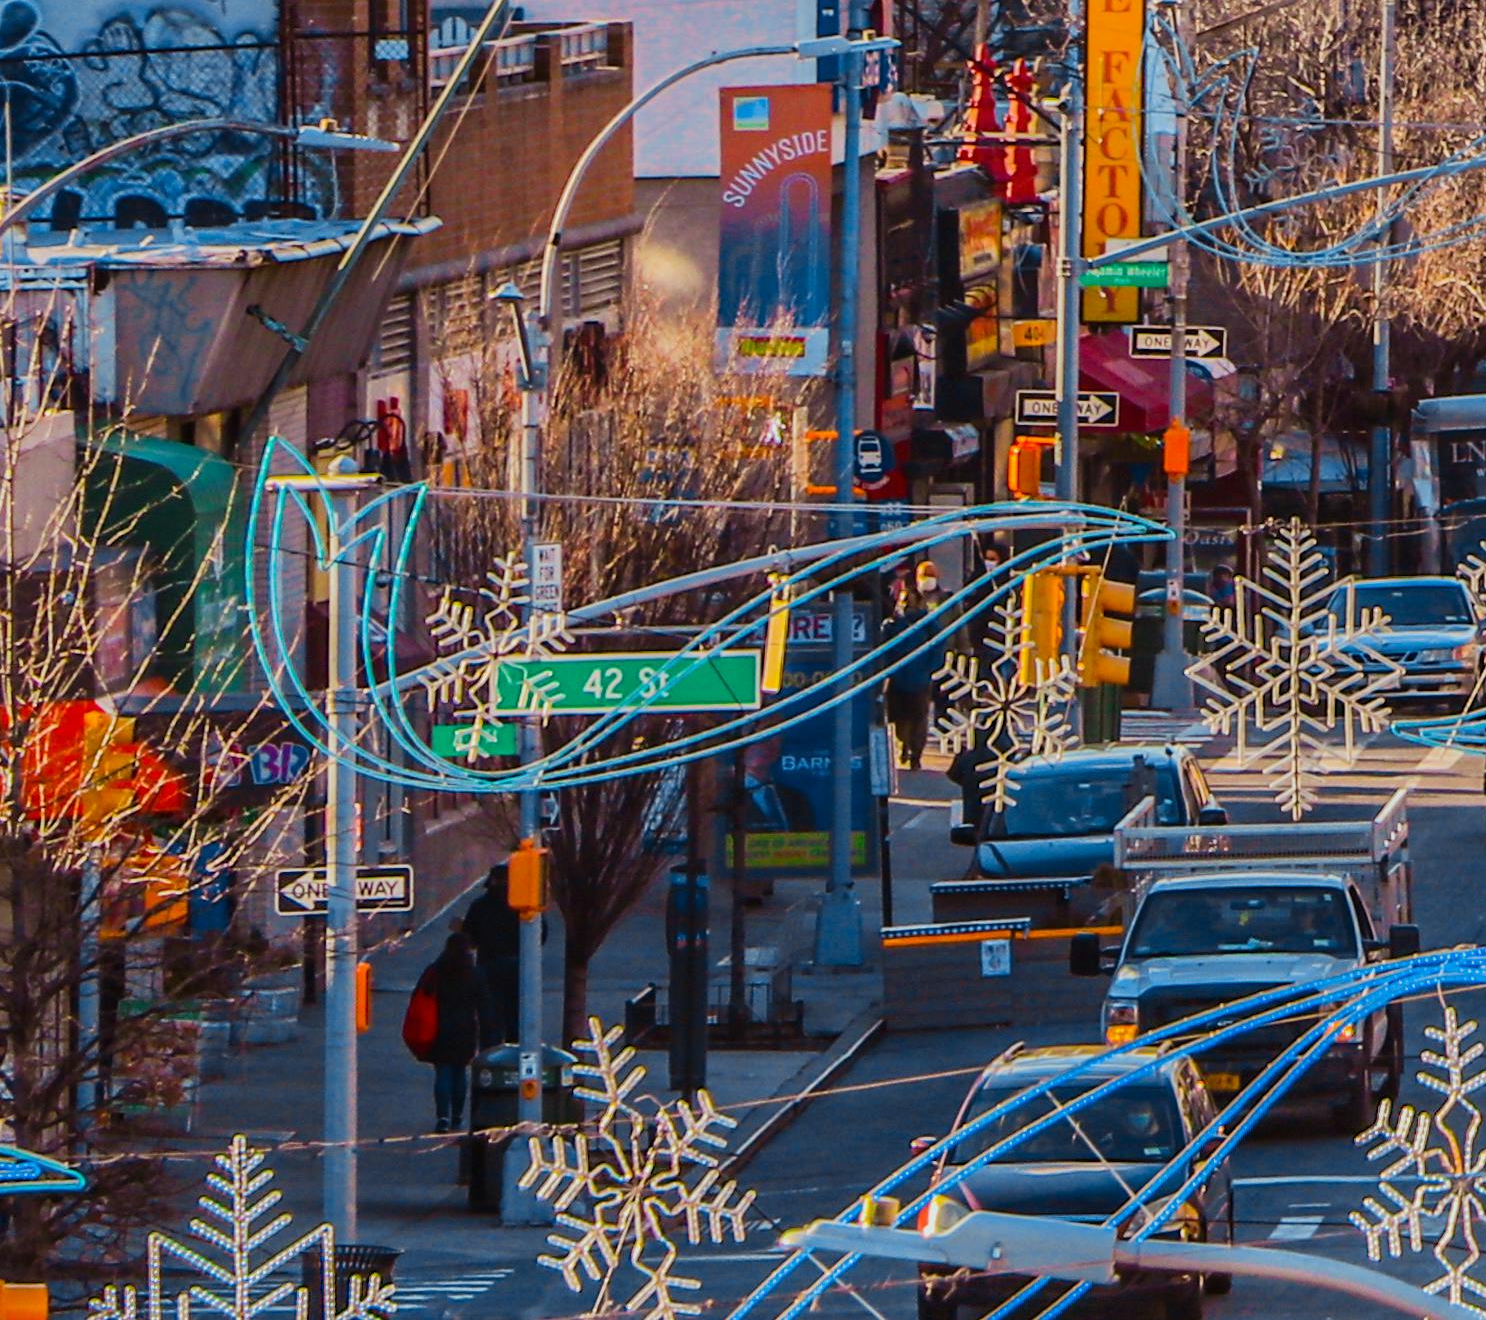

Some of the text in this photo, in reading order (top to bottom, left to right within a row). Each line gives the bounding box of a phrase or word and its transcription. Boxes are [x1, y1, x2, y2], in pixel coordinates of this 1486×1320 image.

[723, 128, 829, 208] SUNNYSIDE
[1093, 49, 1133, 315] FACTOY
[1144, 336, 1210, 349] ONE WAY
[1032, 401, 1103, 414] ONE WAY
[582, 667, 671, 701] 42 St
[291, 880, 399, 899] ONE WAY
